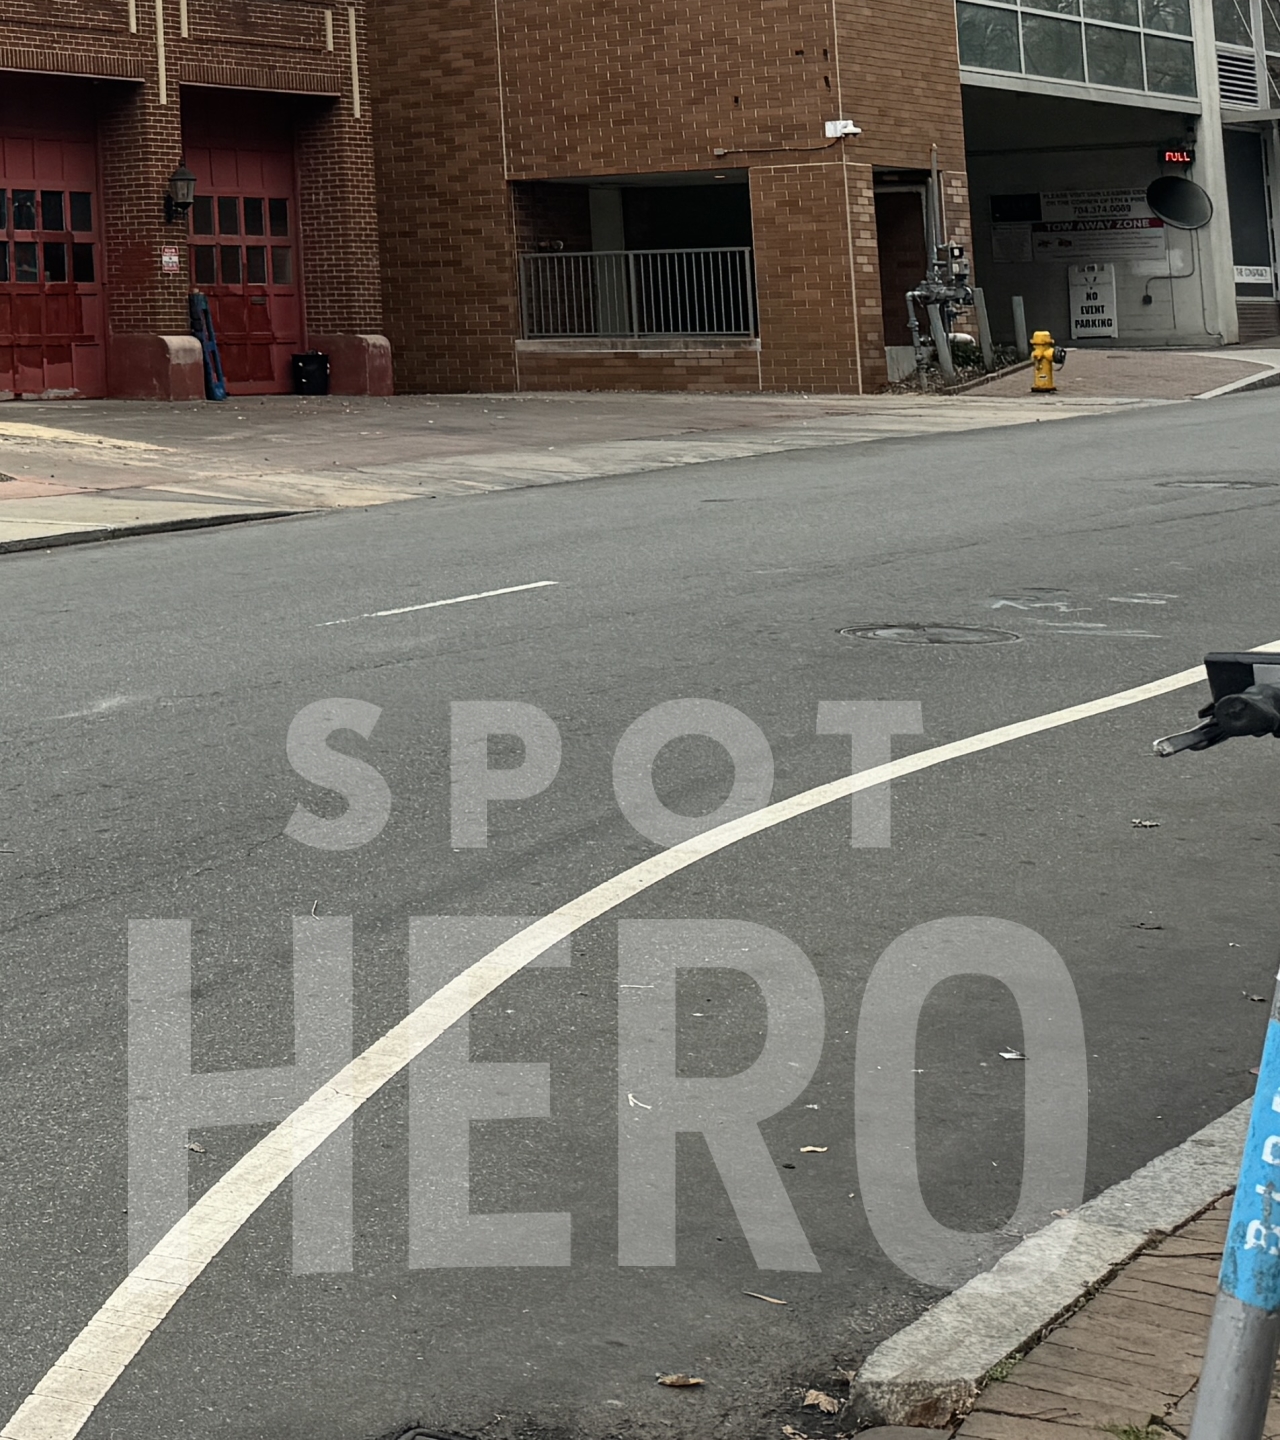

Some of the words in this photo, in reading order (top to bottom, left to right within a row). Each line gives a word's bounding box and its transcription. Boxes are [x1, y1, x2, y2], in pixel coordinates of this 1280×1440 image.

[1165, 151, 1191, 162] FULL
[1046, 223, 1073, 231] TOW
[1077, 221, 1112, 230] AWAY
[1116, 219, 1151, 229] ZONE
[1085, 291, 1099, 301] NO
[1080, 304, 1105, 315] EVENT
[1074, 318, 1113, 329] PARKING
